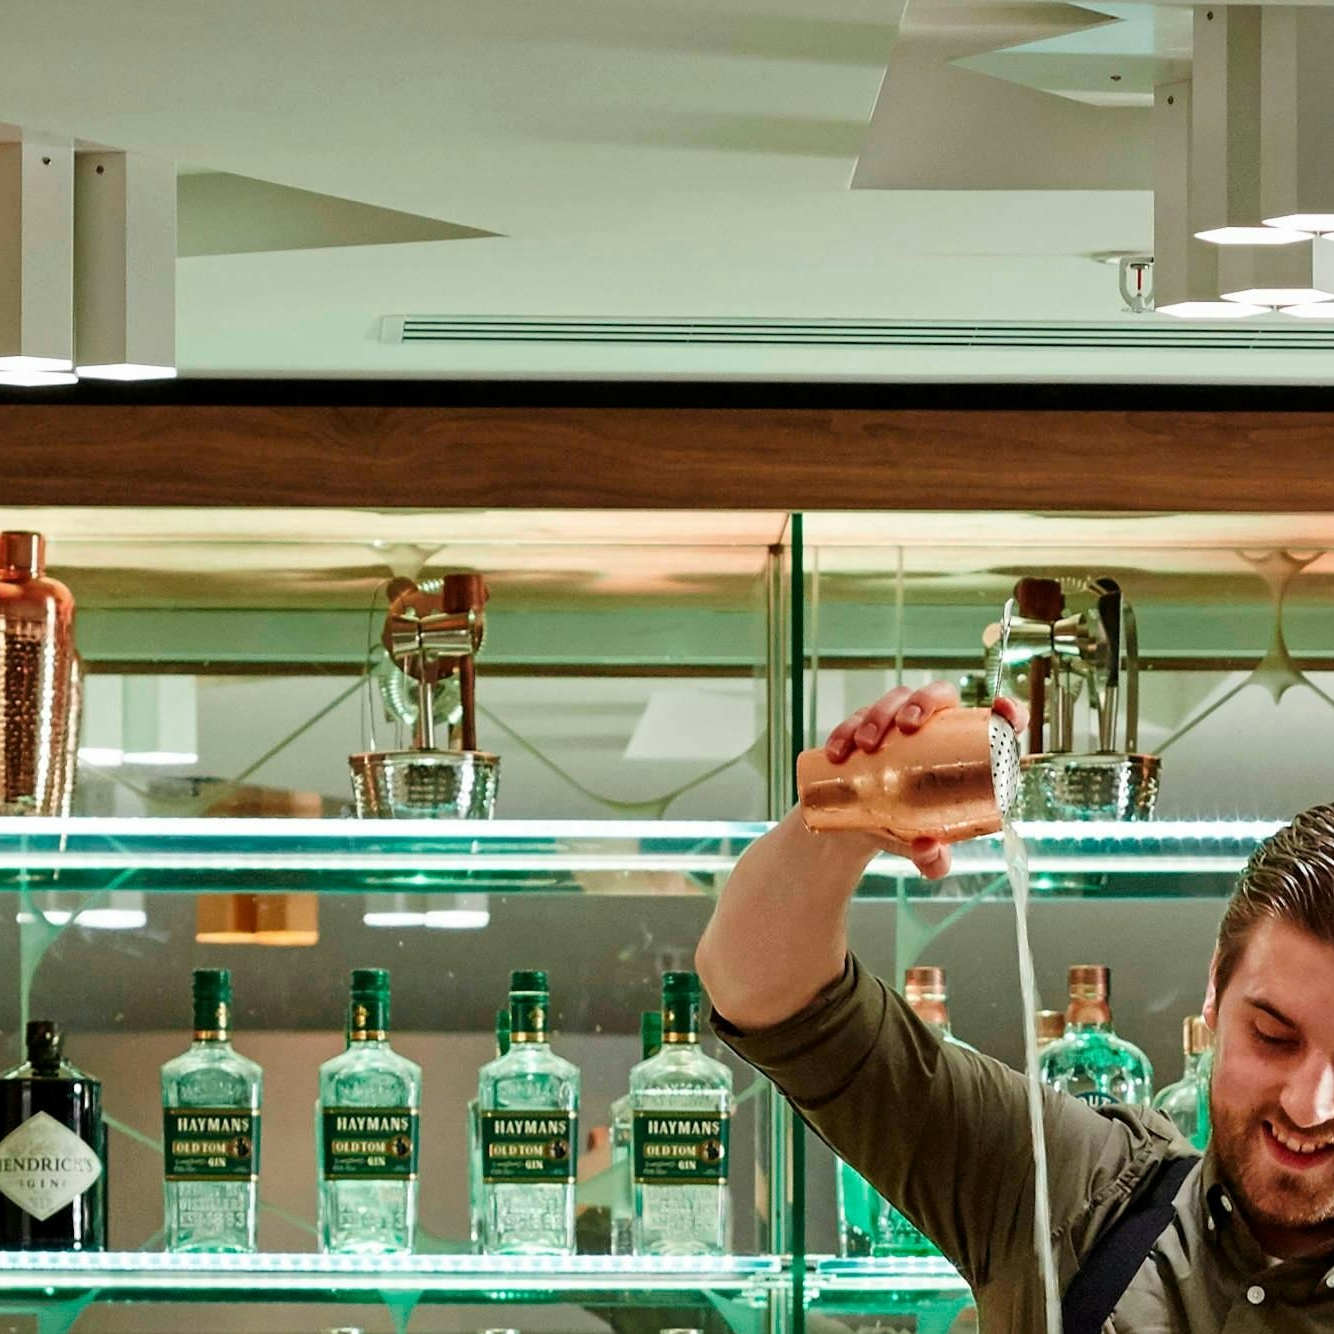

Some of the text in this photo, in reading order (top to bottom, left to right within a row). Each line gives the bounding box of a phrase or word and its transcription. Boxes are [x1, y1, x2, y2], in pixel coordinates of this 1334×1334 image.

[201, 1141, 227, 1153] TOM
[360, 1141, 386, 1152] TOM
[518, 1144, 544, 1155] TOM
[671, 1145, 697, 1156] TOM
[208, 1157, 226, 1167] GIN
[367, 1156, 385, 1166] GIN
[525, 1160, 543, 1170] GIN
[678, 1160, 696, 1170] GIN
[27, 1179, 58, 1188] GIN
